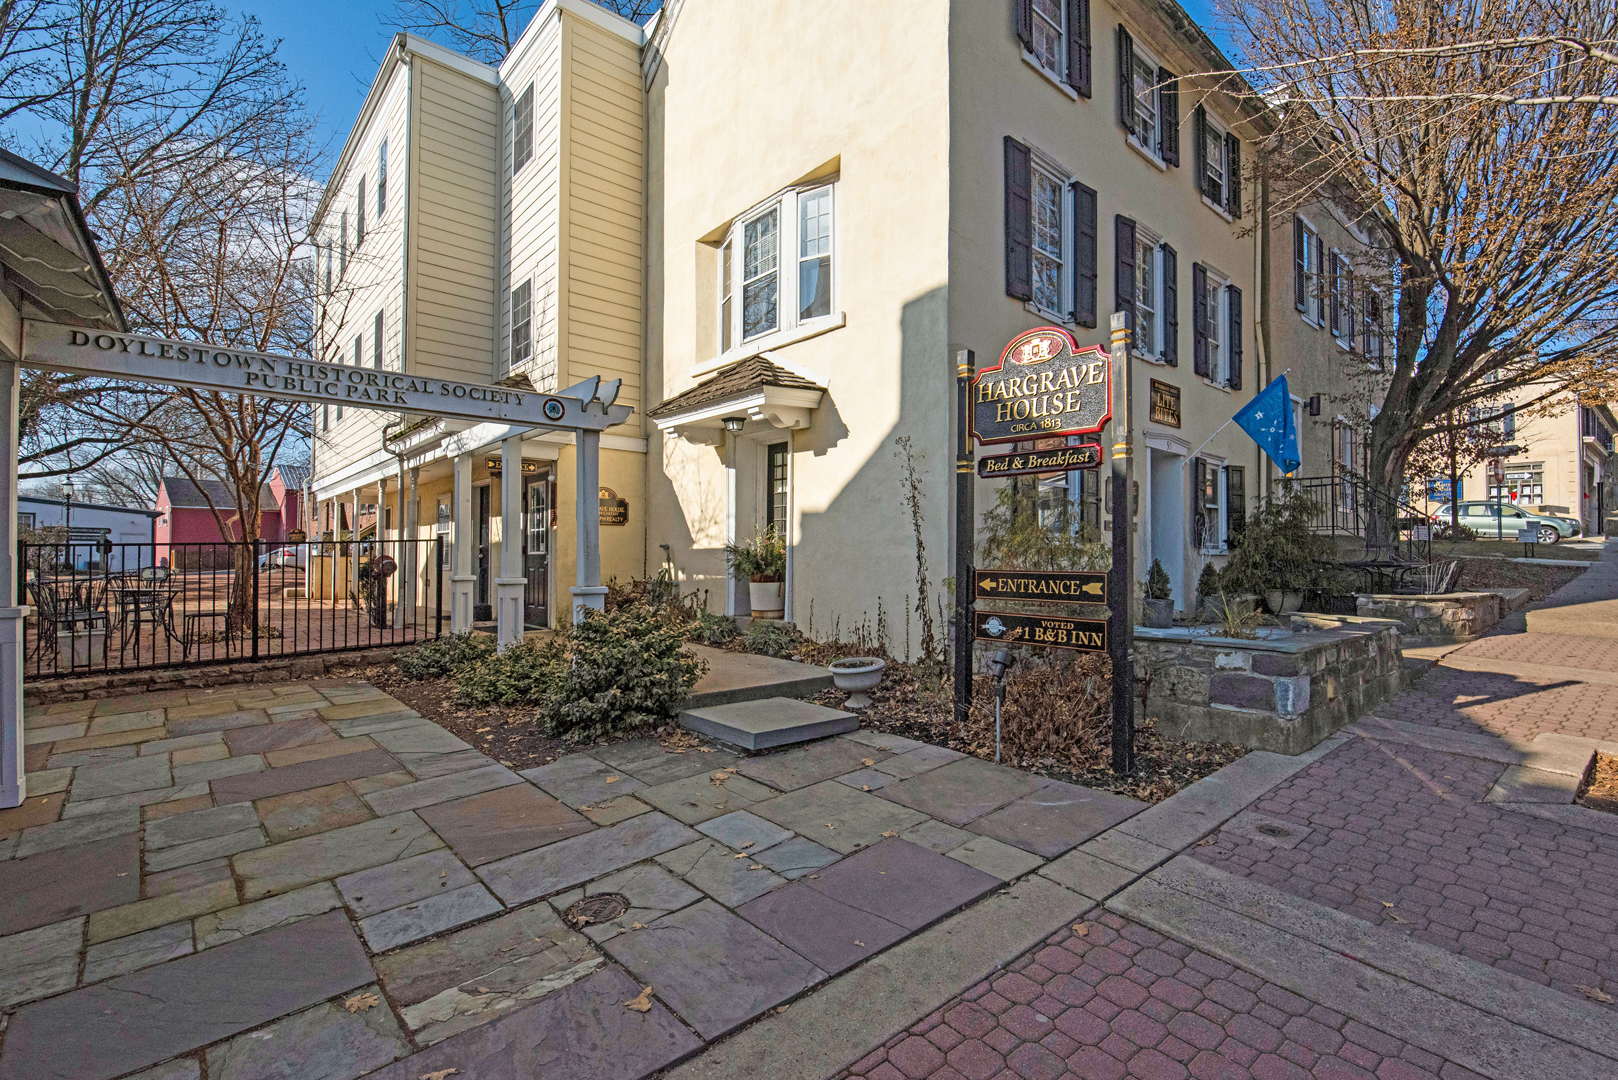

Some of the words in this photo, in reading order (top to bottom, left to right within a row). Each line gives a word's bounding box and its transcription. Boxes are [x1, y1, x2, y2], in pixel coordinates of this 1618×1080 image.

[69, 330, 278, 373] DOYLESTOWN
[286, 361, 434, 394] HISTORICAL
[440, 383, 526, 406] SOCIETY
[244, 371, 339, 397] PUBLIC
[345, 384, 409, 405] PARK
[977, 361, 1105, 403] HARGRAVE
[995, 390, 1081, 423] HOUSE
[1157, 392, 1176, 410] LITE
[1010, 421, 1038, 433] CIRCA
[1040, 418, 1062, 430] 1813
[1154, 406, 1179, 425] BITES
[986, 457, 1009, 472] Bed
[1012, 456, 1024, 470] &
[1027, 450, 1090, 468] Breakfast
[997, 578, 1081, 595] ENTRANCE
[1041, 620, 1075, 630] VOTED
[1015, 626, 1031, 639] #1
[1034, 627, 1067, 643] B&B
[1070, 631, 1104, 647] INN
